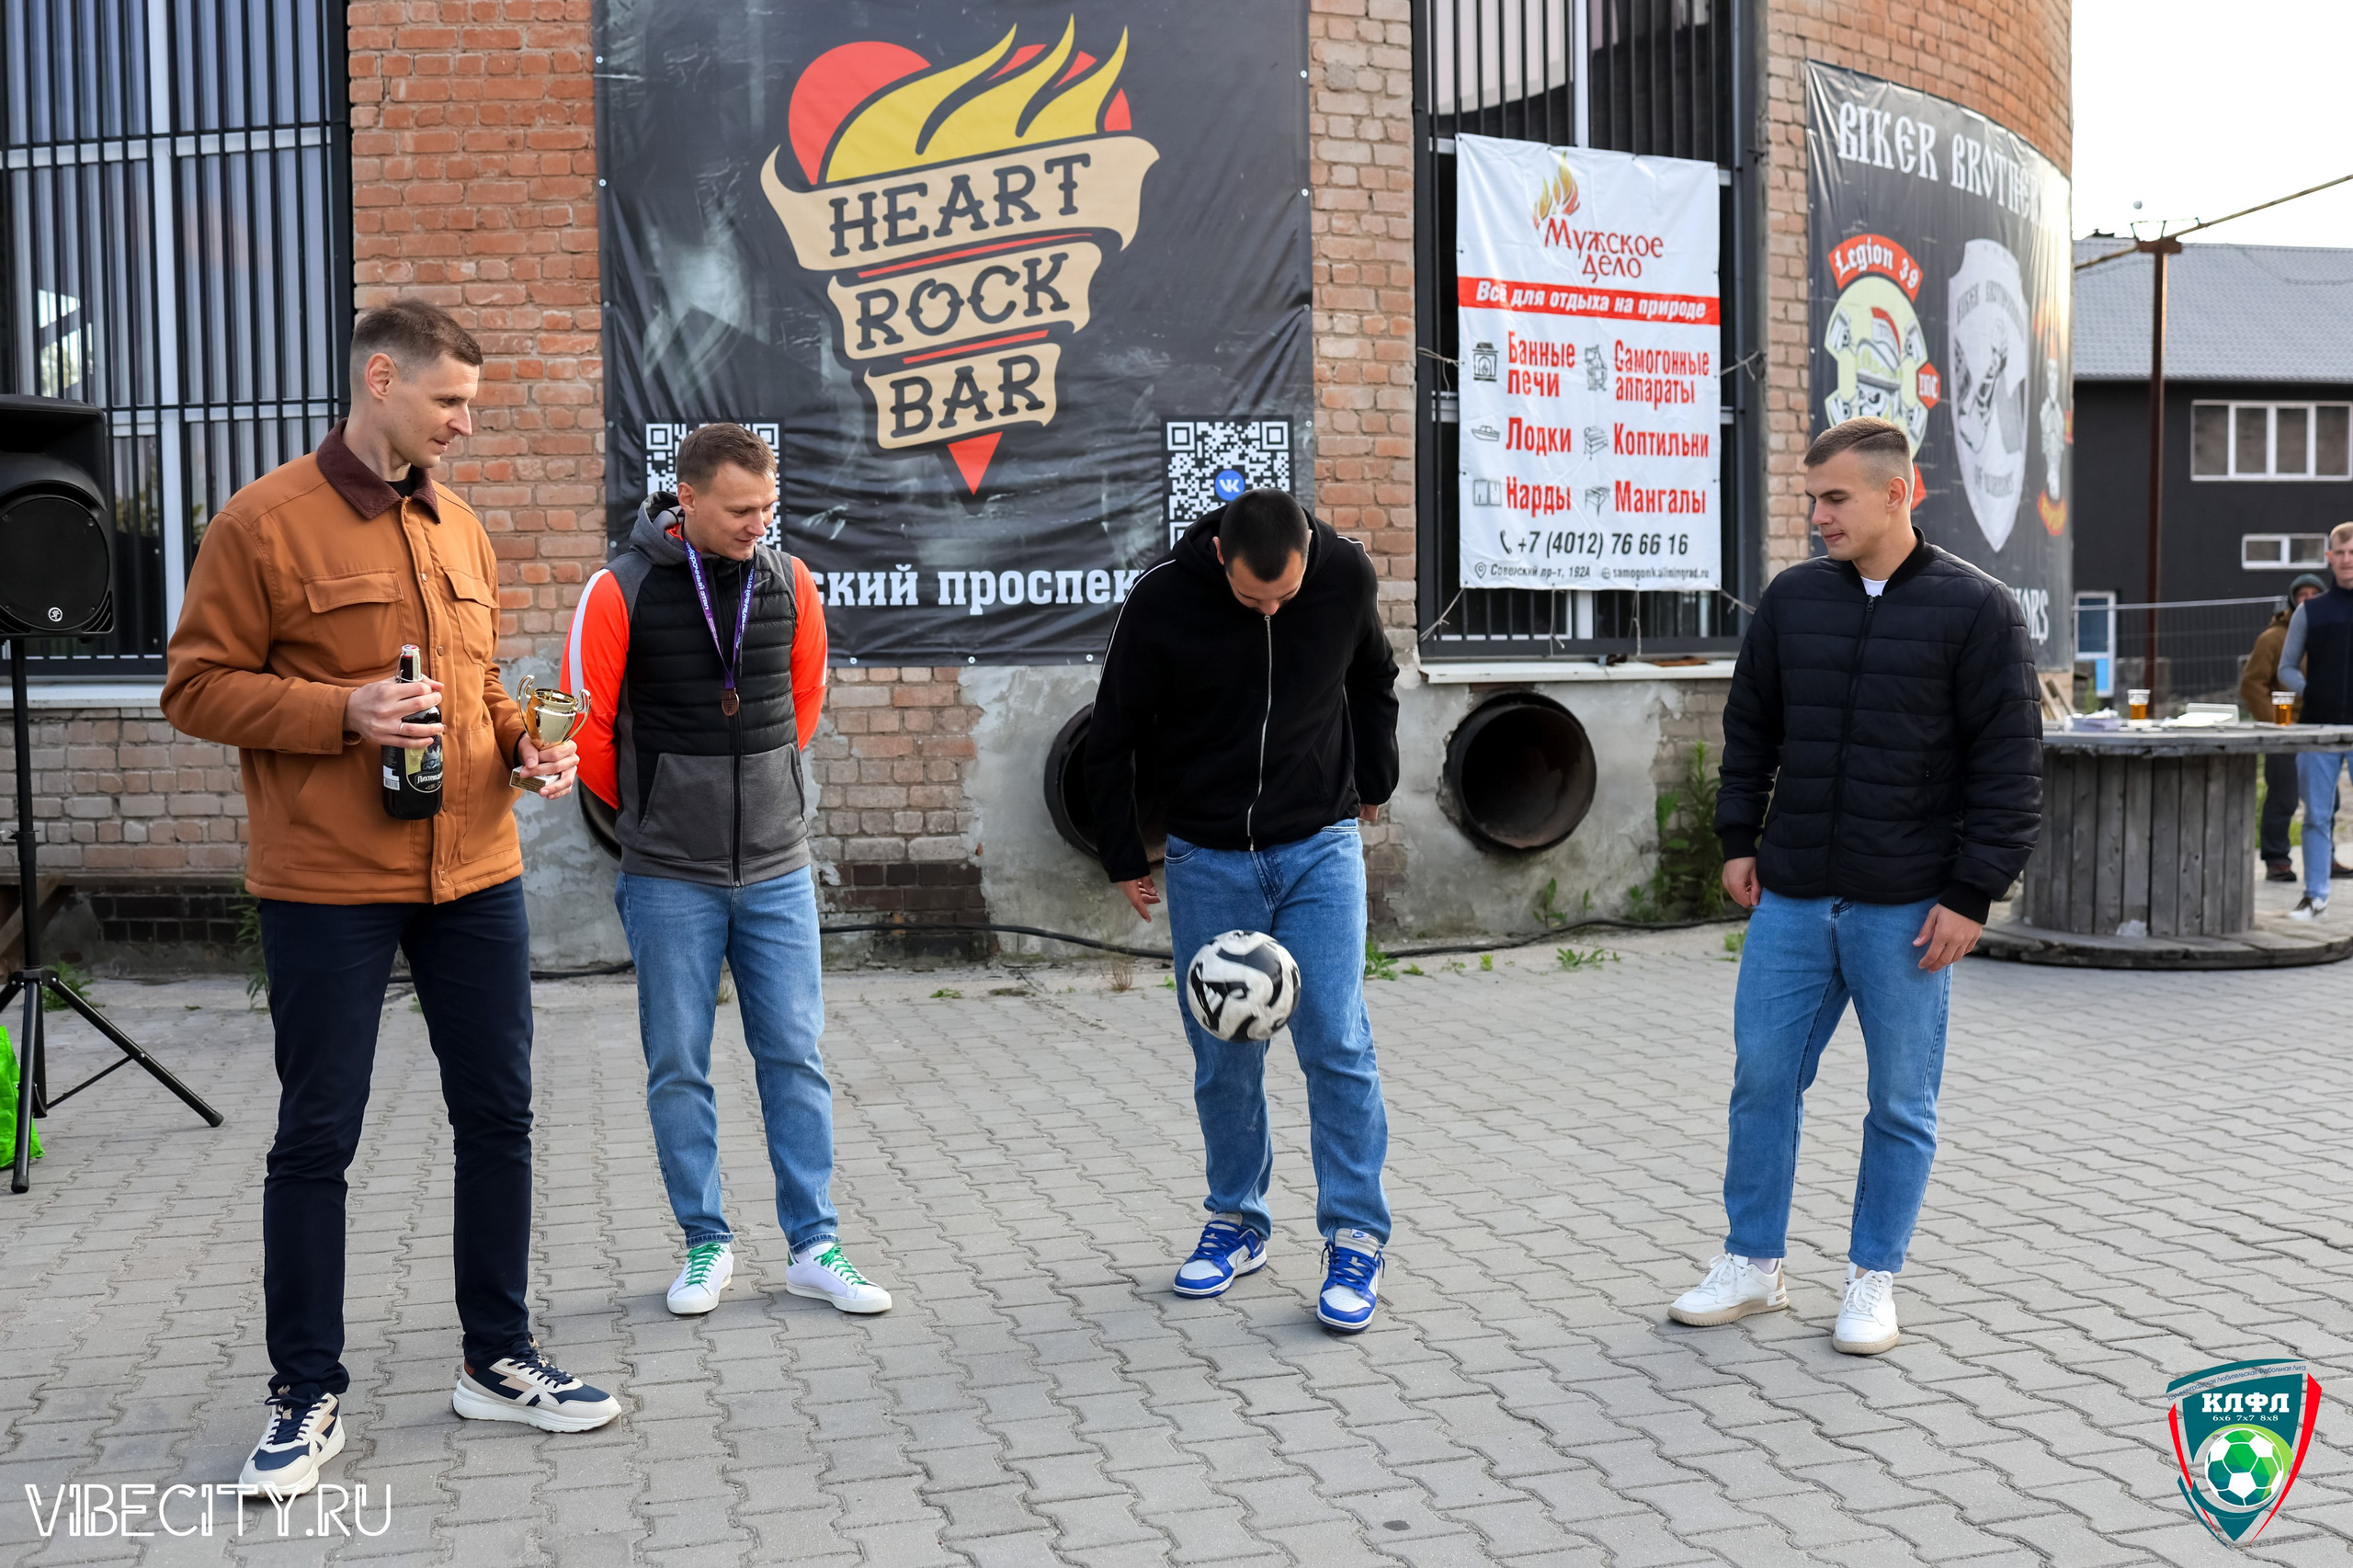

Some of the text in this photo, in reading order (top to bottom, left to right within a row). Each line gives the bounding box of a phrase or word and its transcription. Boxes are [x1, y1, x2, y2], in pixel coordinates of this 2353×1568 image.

[1836, 99, 2042, 226] BIKER BROTHER
[829, 153, 1091, 257] HEART
[1544, 217, 1665, 259] Мужское
[1835, 236, 1920, 290] Legion 39
[855, 252, 1070, 351] ROCK
[1476, 279, 1707, 320] Всё для отдыха на природе
[1507, 329, 1576, 369] Банные
[1614, 338, 1711, 377] Самогонные
[889, 354, 1046, 439] BAR
[1507, 369, 1561, 398] печи
[1615, 377, 1696, 411] аппараты
[1506, 416, 1572, 457] Лодки
[1614, 422, 1710, 459] Коптильни
[1506, 475, 1572, 518] Нарды
[1614, 479, 1707, 515] Мангалы
[1518, 530, 1689, 560] +7 (4012) 76 66 16
[938, 568, 1146, 616] проспек
[2008, 587, 2049, 646] ORS
